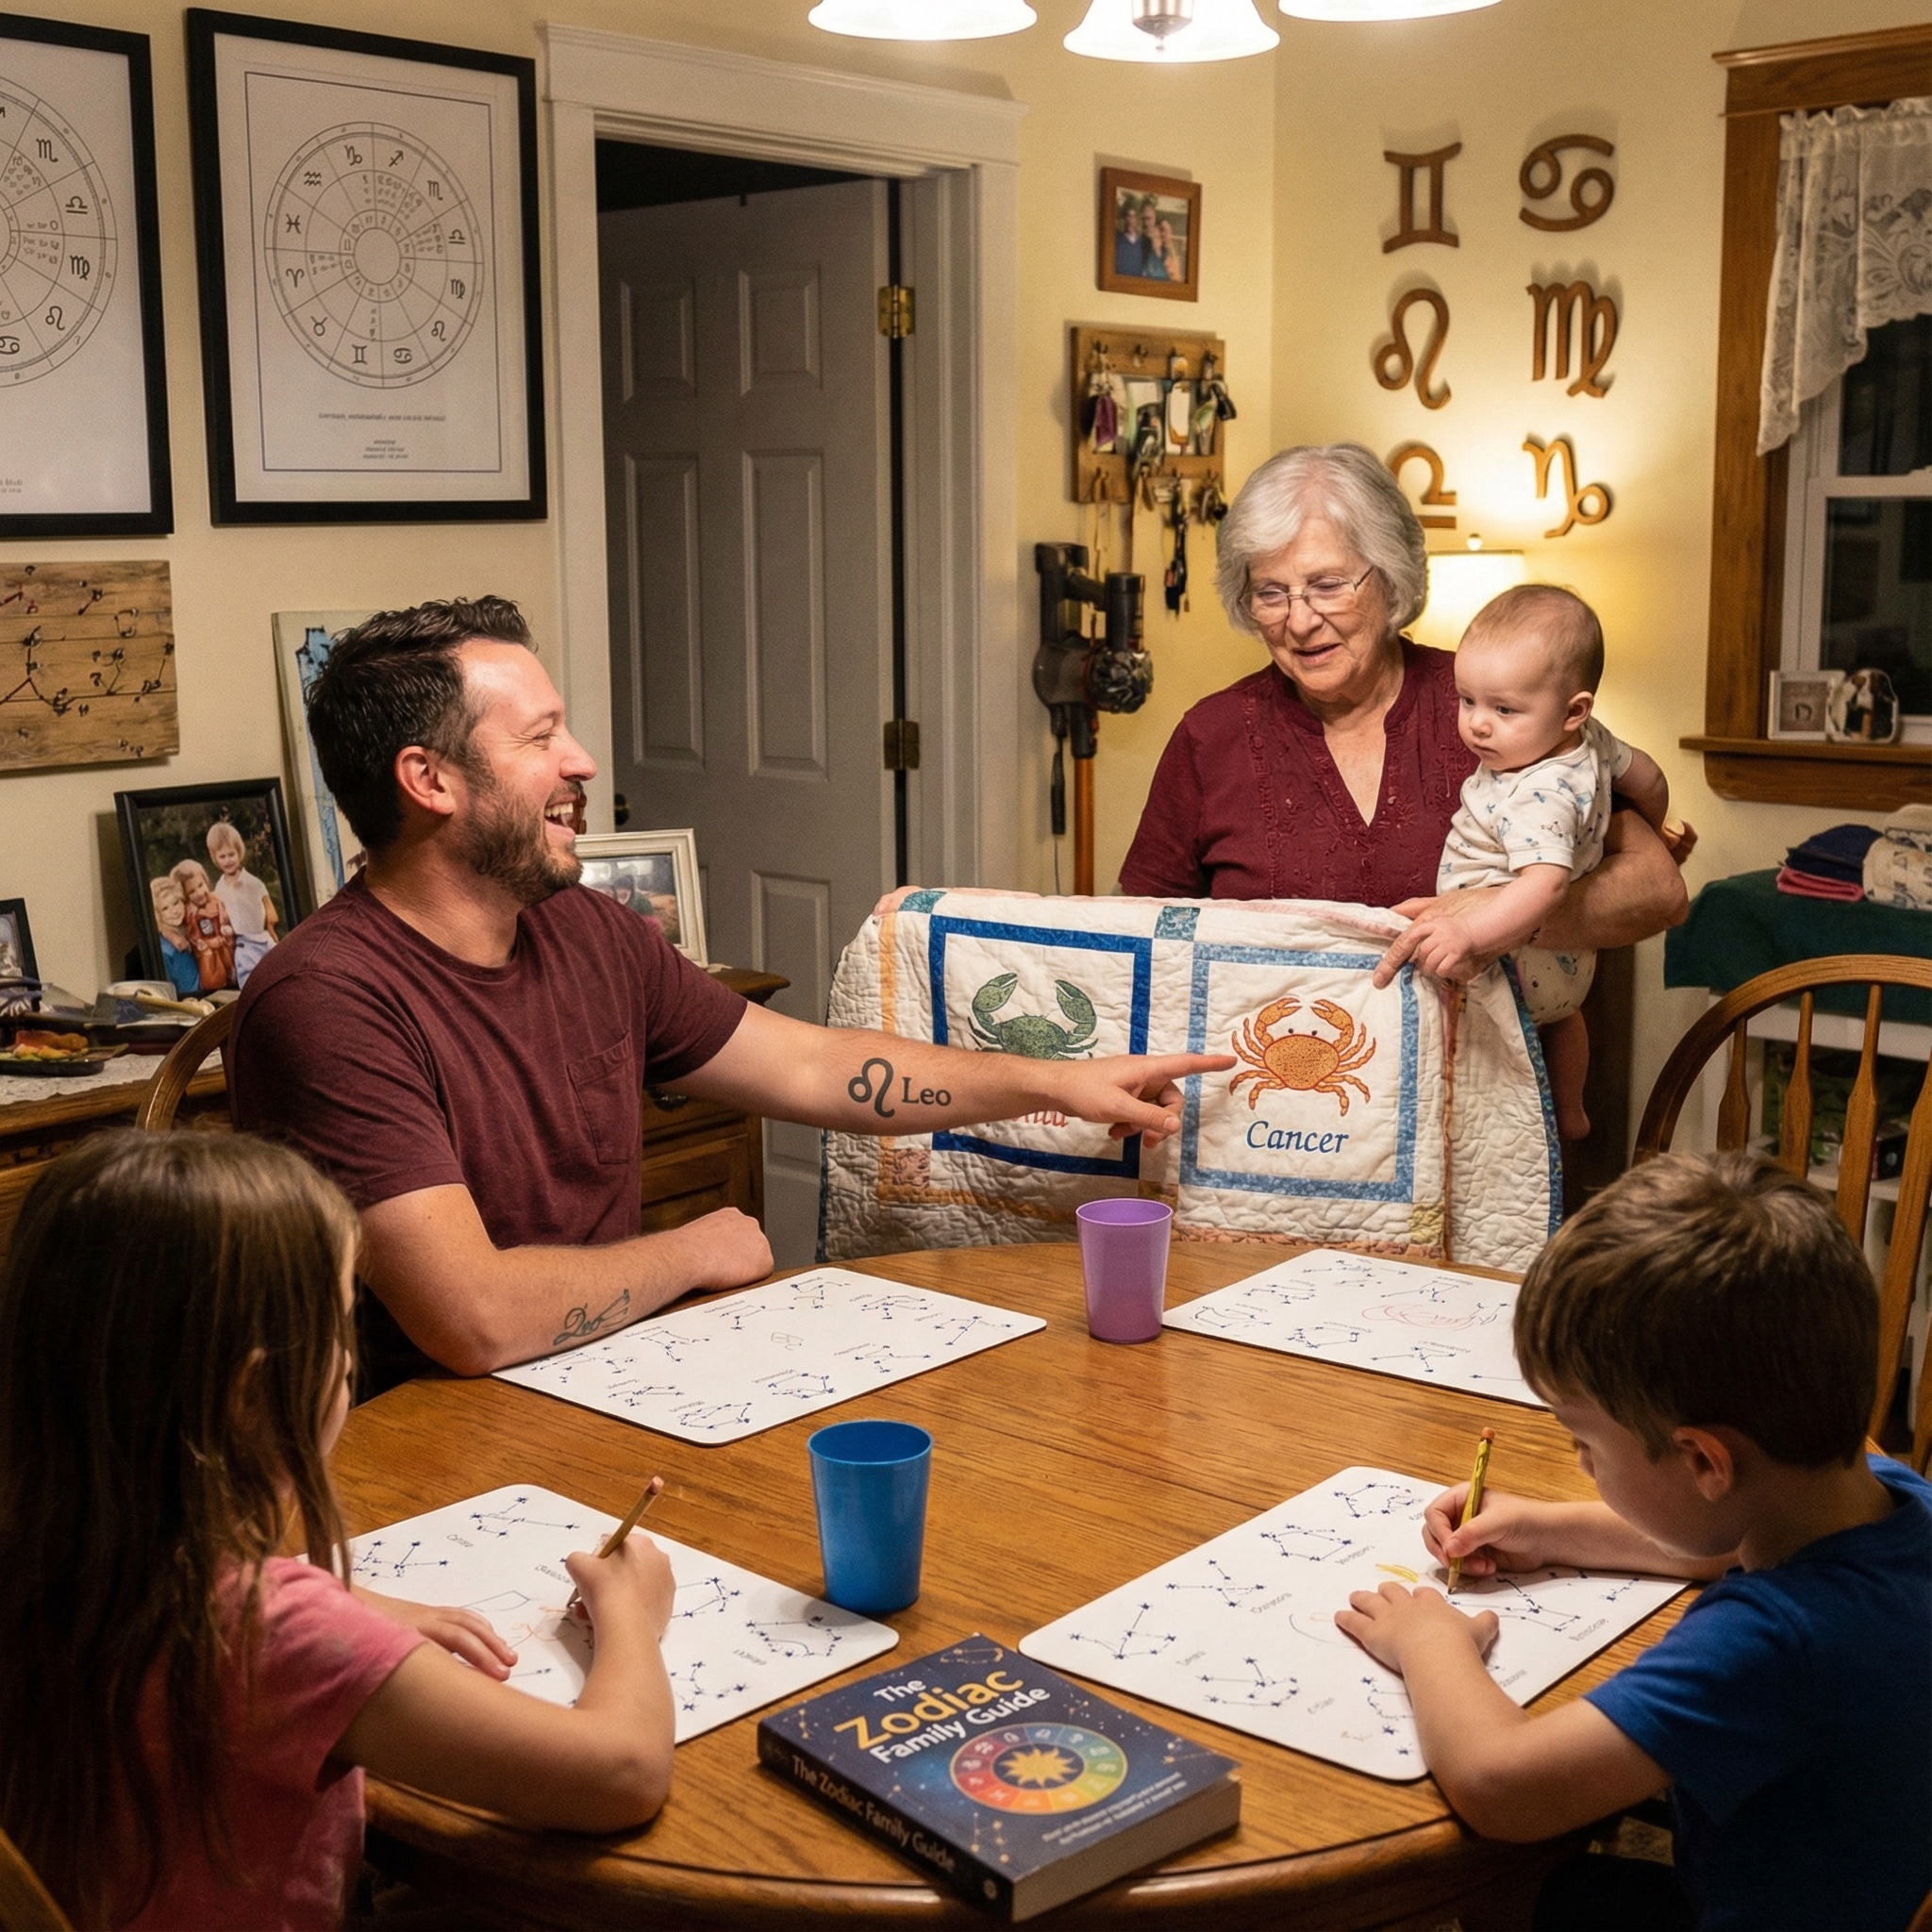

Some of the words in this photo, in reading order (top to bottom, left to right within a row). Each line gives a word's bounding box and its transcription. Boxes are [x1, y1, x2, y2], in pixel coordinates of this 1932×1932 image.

[901, 1076, 952, 1107] Leo
[1246, 1120, 1349, 1154] Cancer
[834, 1671, 1024, 1751] Zodiac
[874, 1678, 926, 1704] The
[870, 1721, 967, 1764] Family
[966, 1687, 1051, 1725] Guide
[791, 1755, 818, 1786] The
[819, 1773, 864, 1817] Zodiac
[865, 1802, 910, 1848] Family
[911, 1831, 956, 1873] Guide
